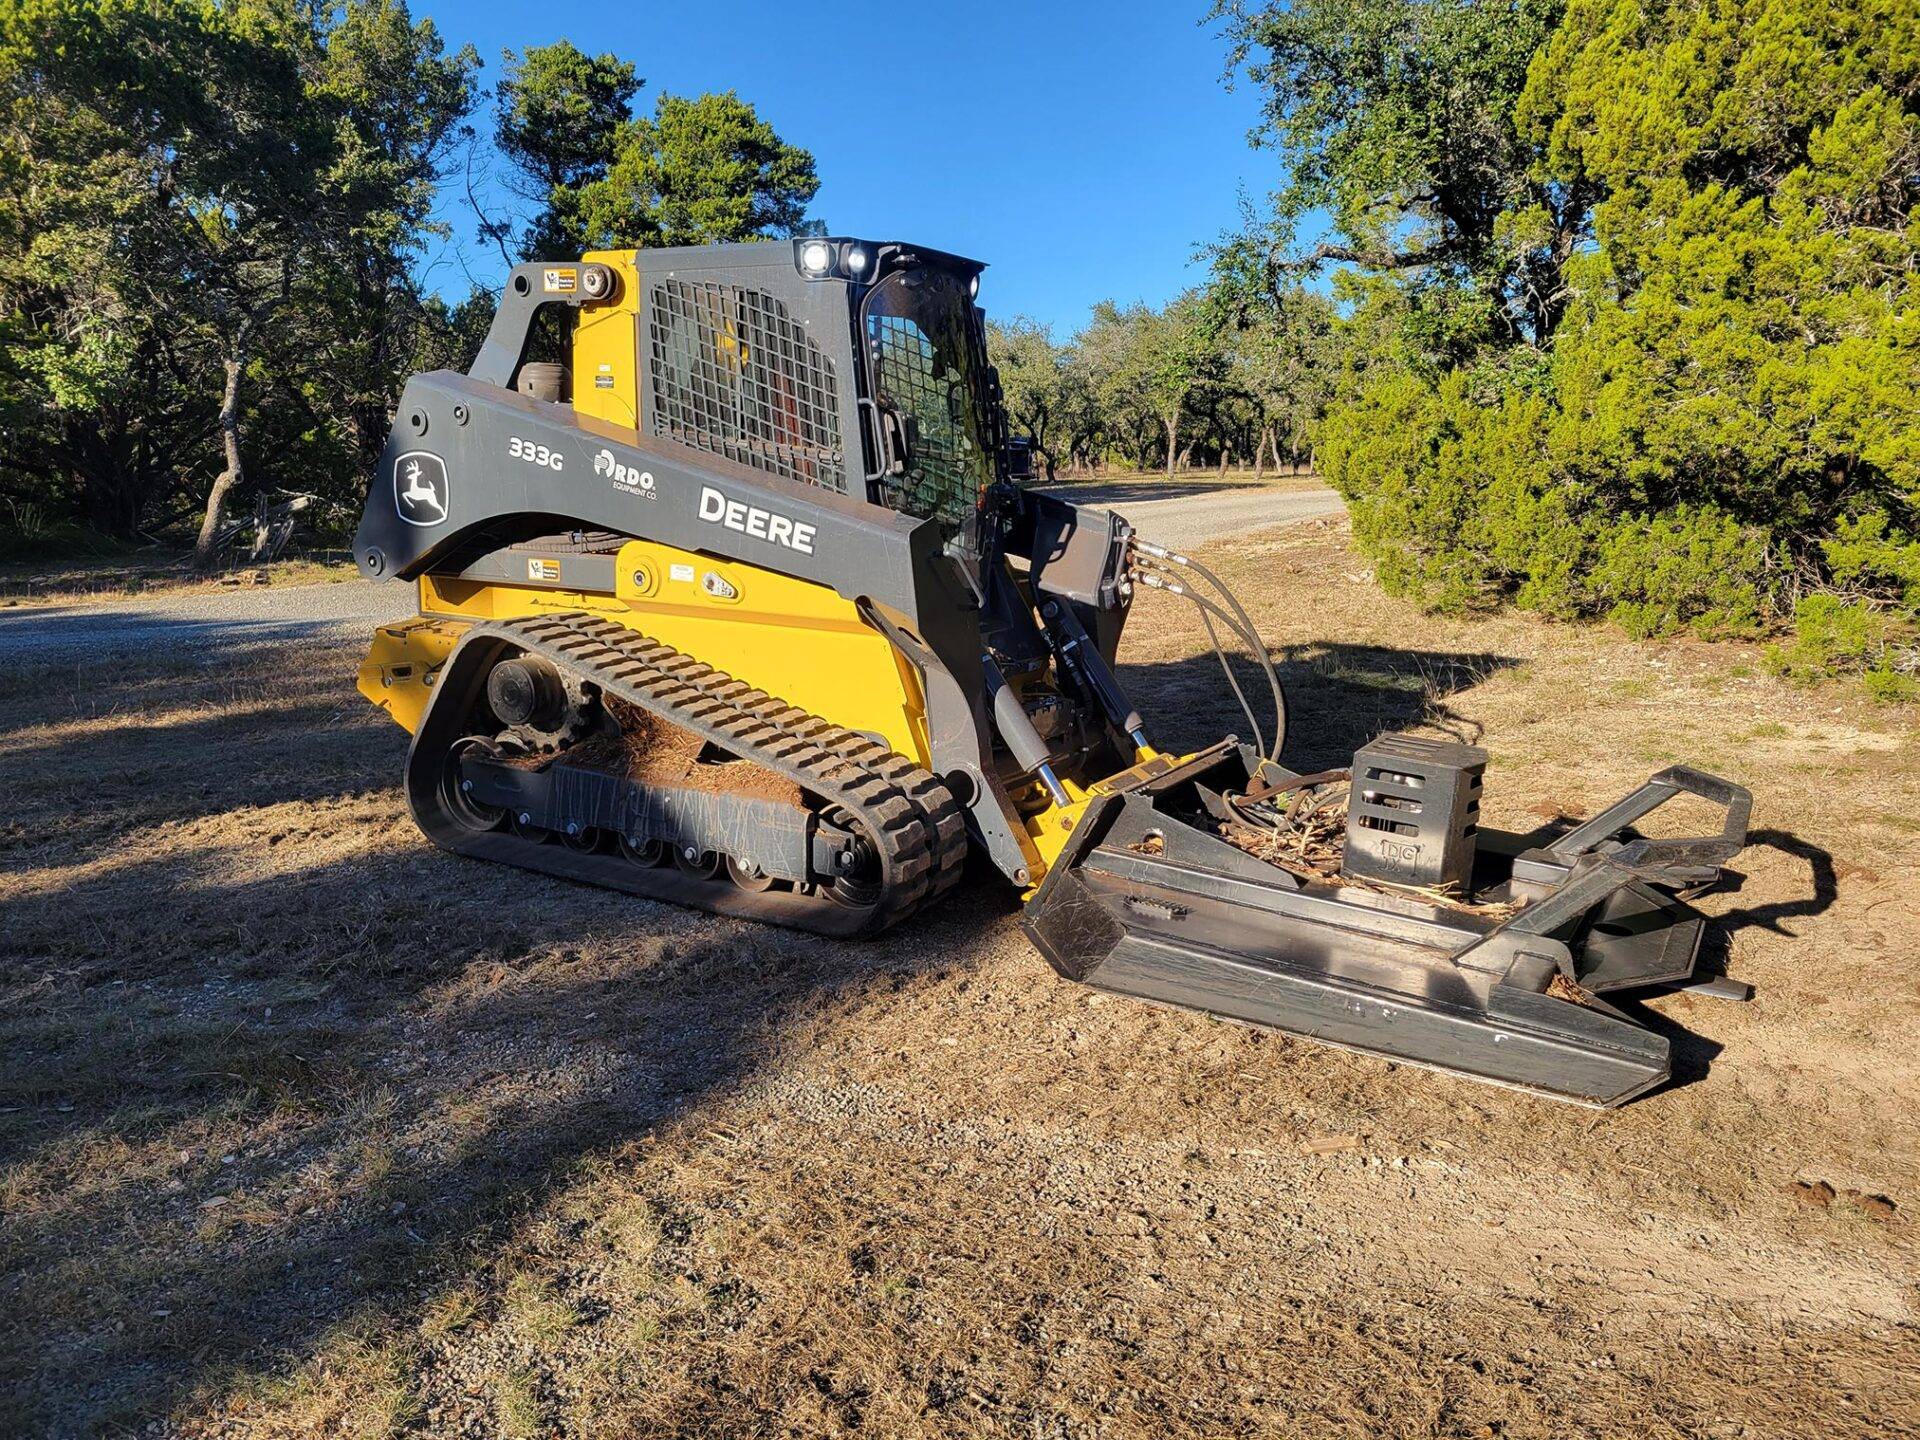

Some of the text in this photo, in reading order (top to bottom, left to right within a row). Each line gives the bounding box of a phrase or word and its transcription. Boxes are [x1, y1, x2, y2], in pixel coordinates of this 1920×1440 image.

[509, 436, 564, 471] 333G
[612, 480, 647, 498] EQUIPMENT
[698, 487, 817, 553] DEERE
